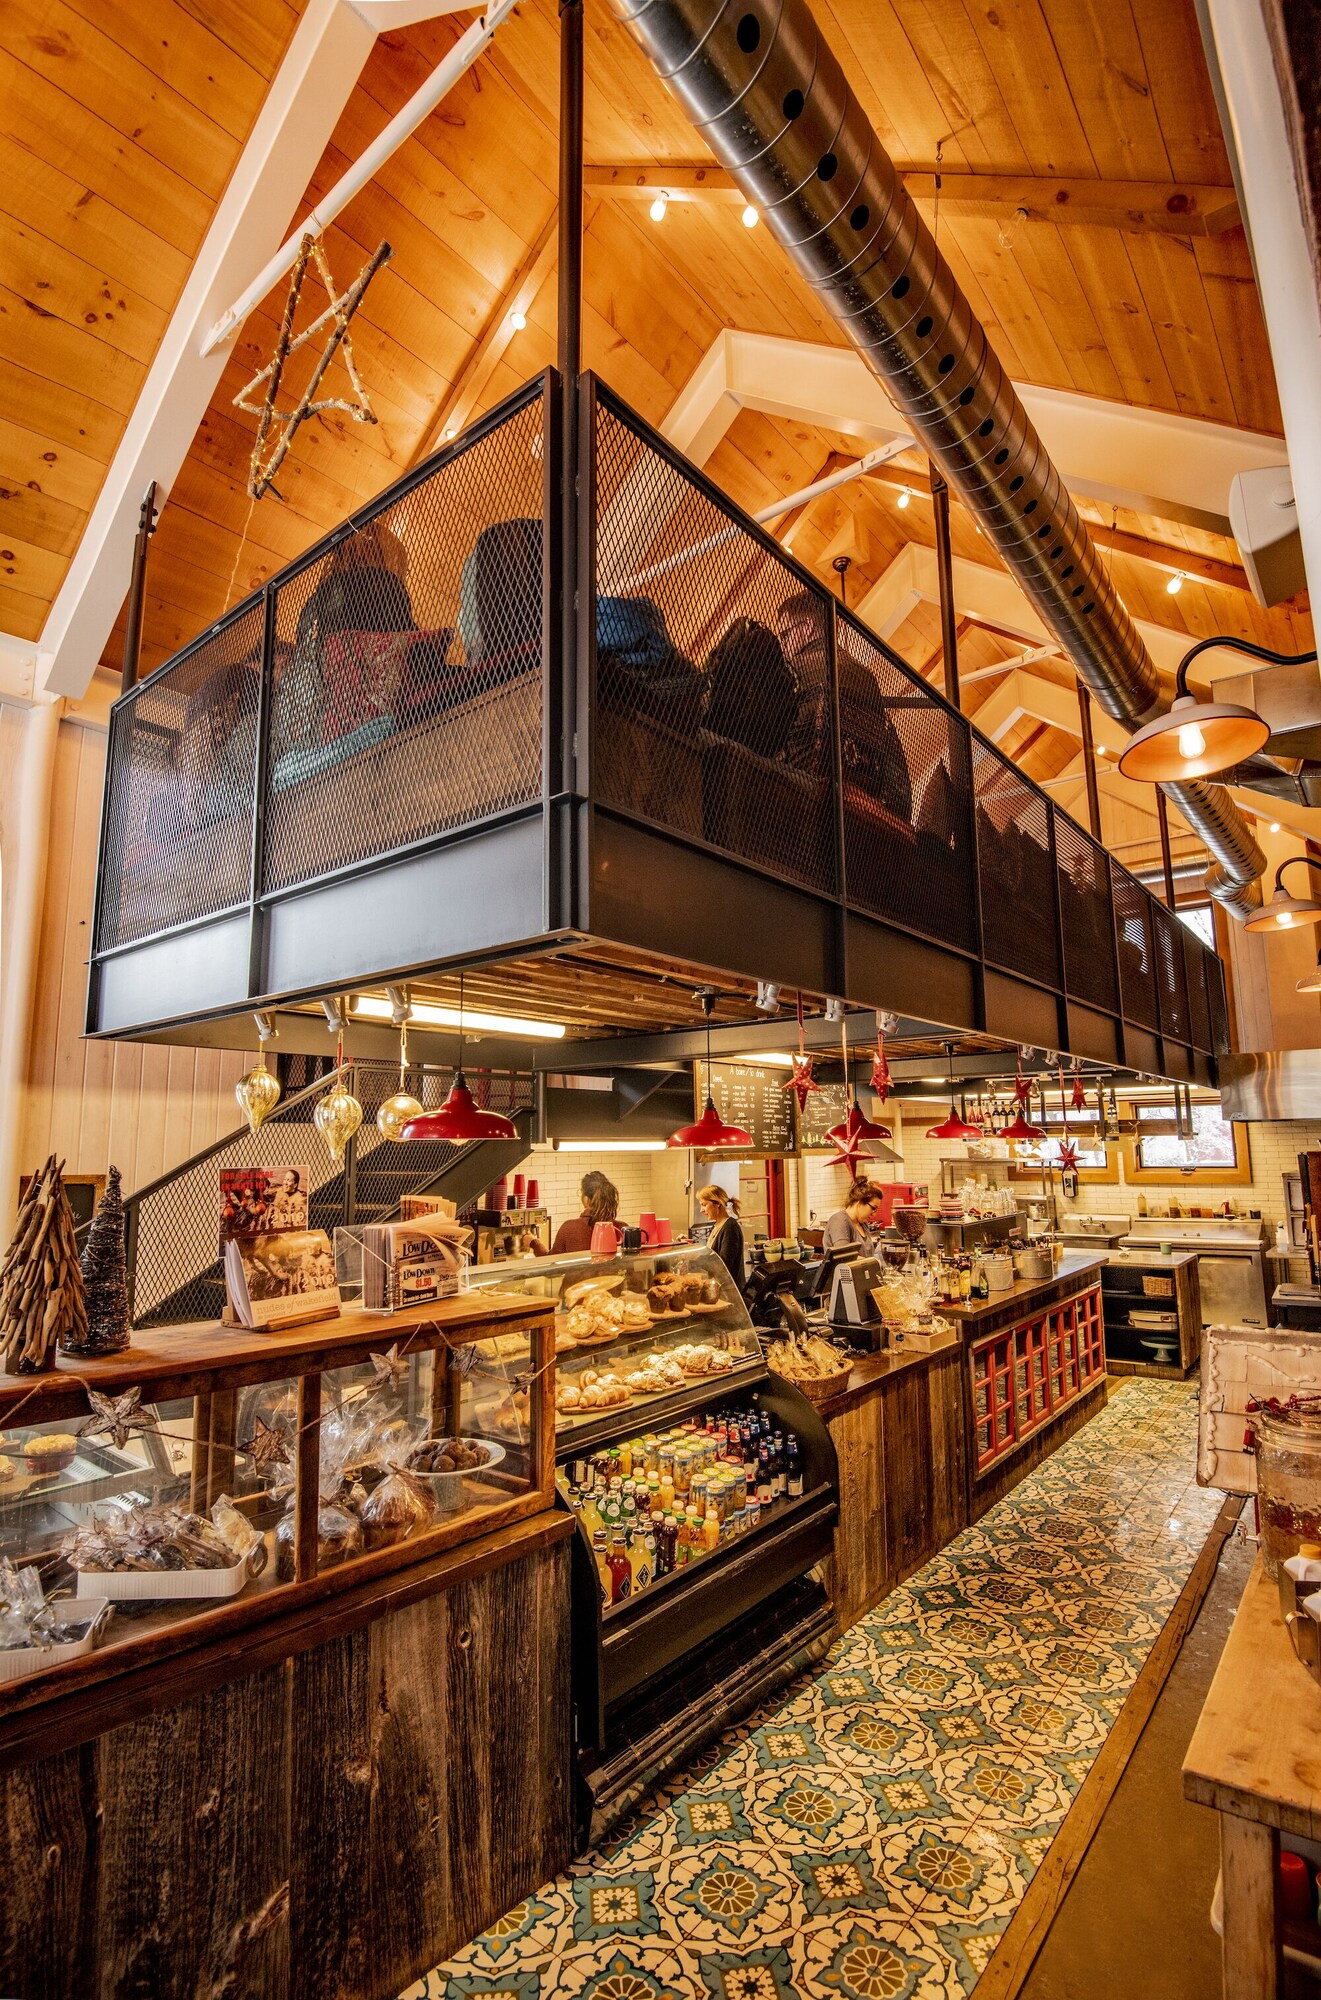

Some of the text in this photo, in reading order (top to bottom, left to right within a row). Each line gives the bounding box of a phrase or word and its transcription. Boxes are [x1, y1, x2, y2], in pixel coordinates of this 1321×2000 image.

[221, 1172, 235, 1180] FOR
[271, 1211, 305, 1225] 2019
[302, 1273, 335, 1289] 2019
[416, 1277, 432, 1289] $1.50
[257, 1302, 286, 1315] nudes
[286, 1297, 297, 1314] of
[295, 1293, 337, 1307] wakefield
